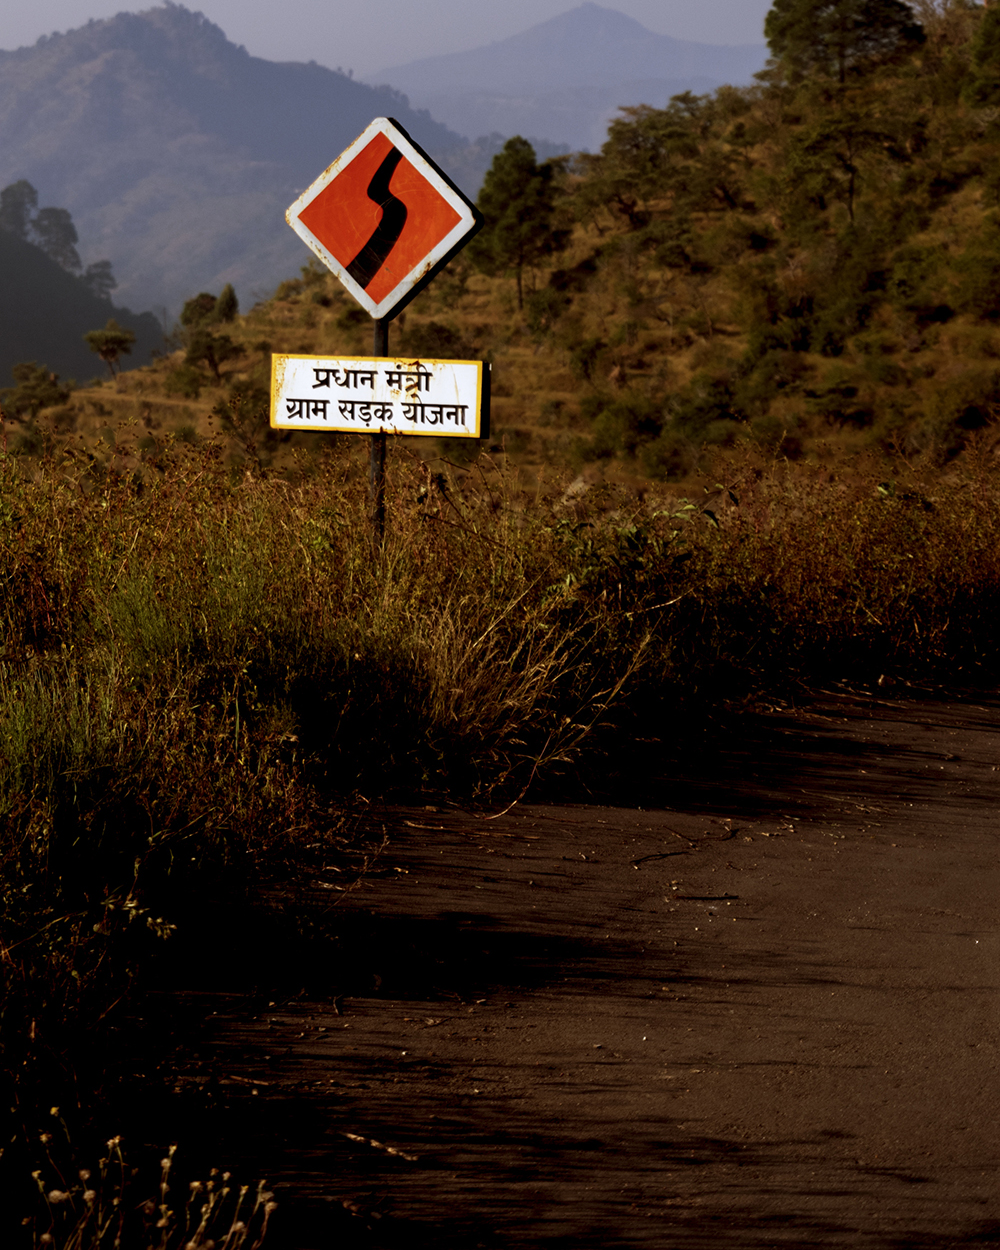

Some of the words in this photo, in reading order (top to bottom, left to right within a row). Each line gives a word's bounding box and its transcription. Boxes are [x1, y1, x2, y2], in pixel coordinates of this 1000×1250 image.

[312, 368, 379, 390] प्रधान
[384, 363, 433, 392] मंत्री
[286, 398, 330, 421] ग्राम
[338, 400, 393, 427] सड़क
[401, 393, 469, 426] योजना
